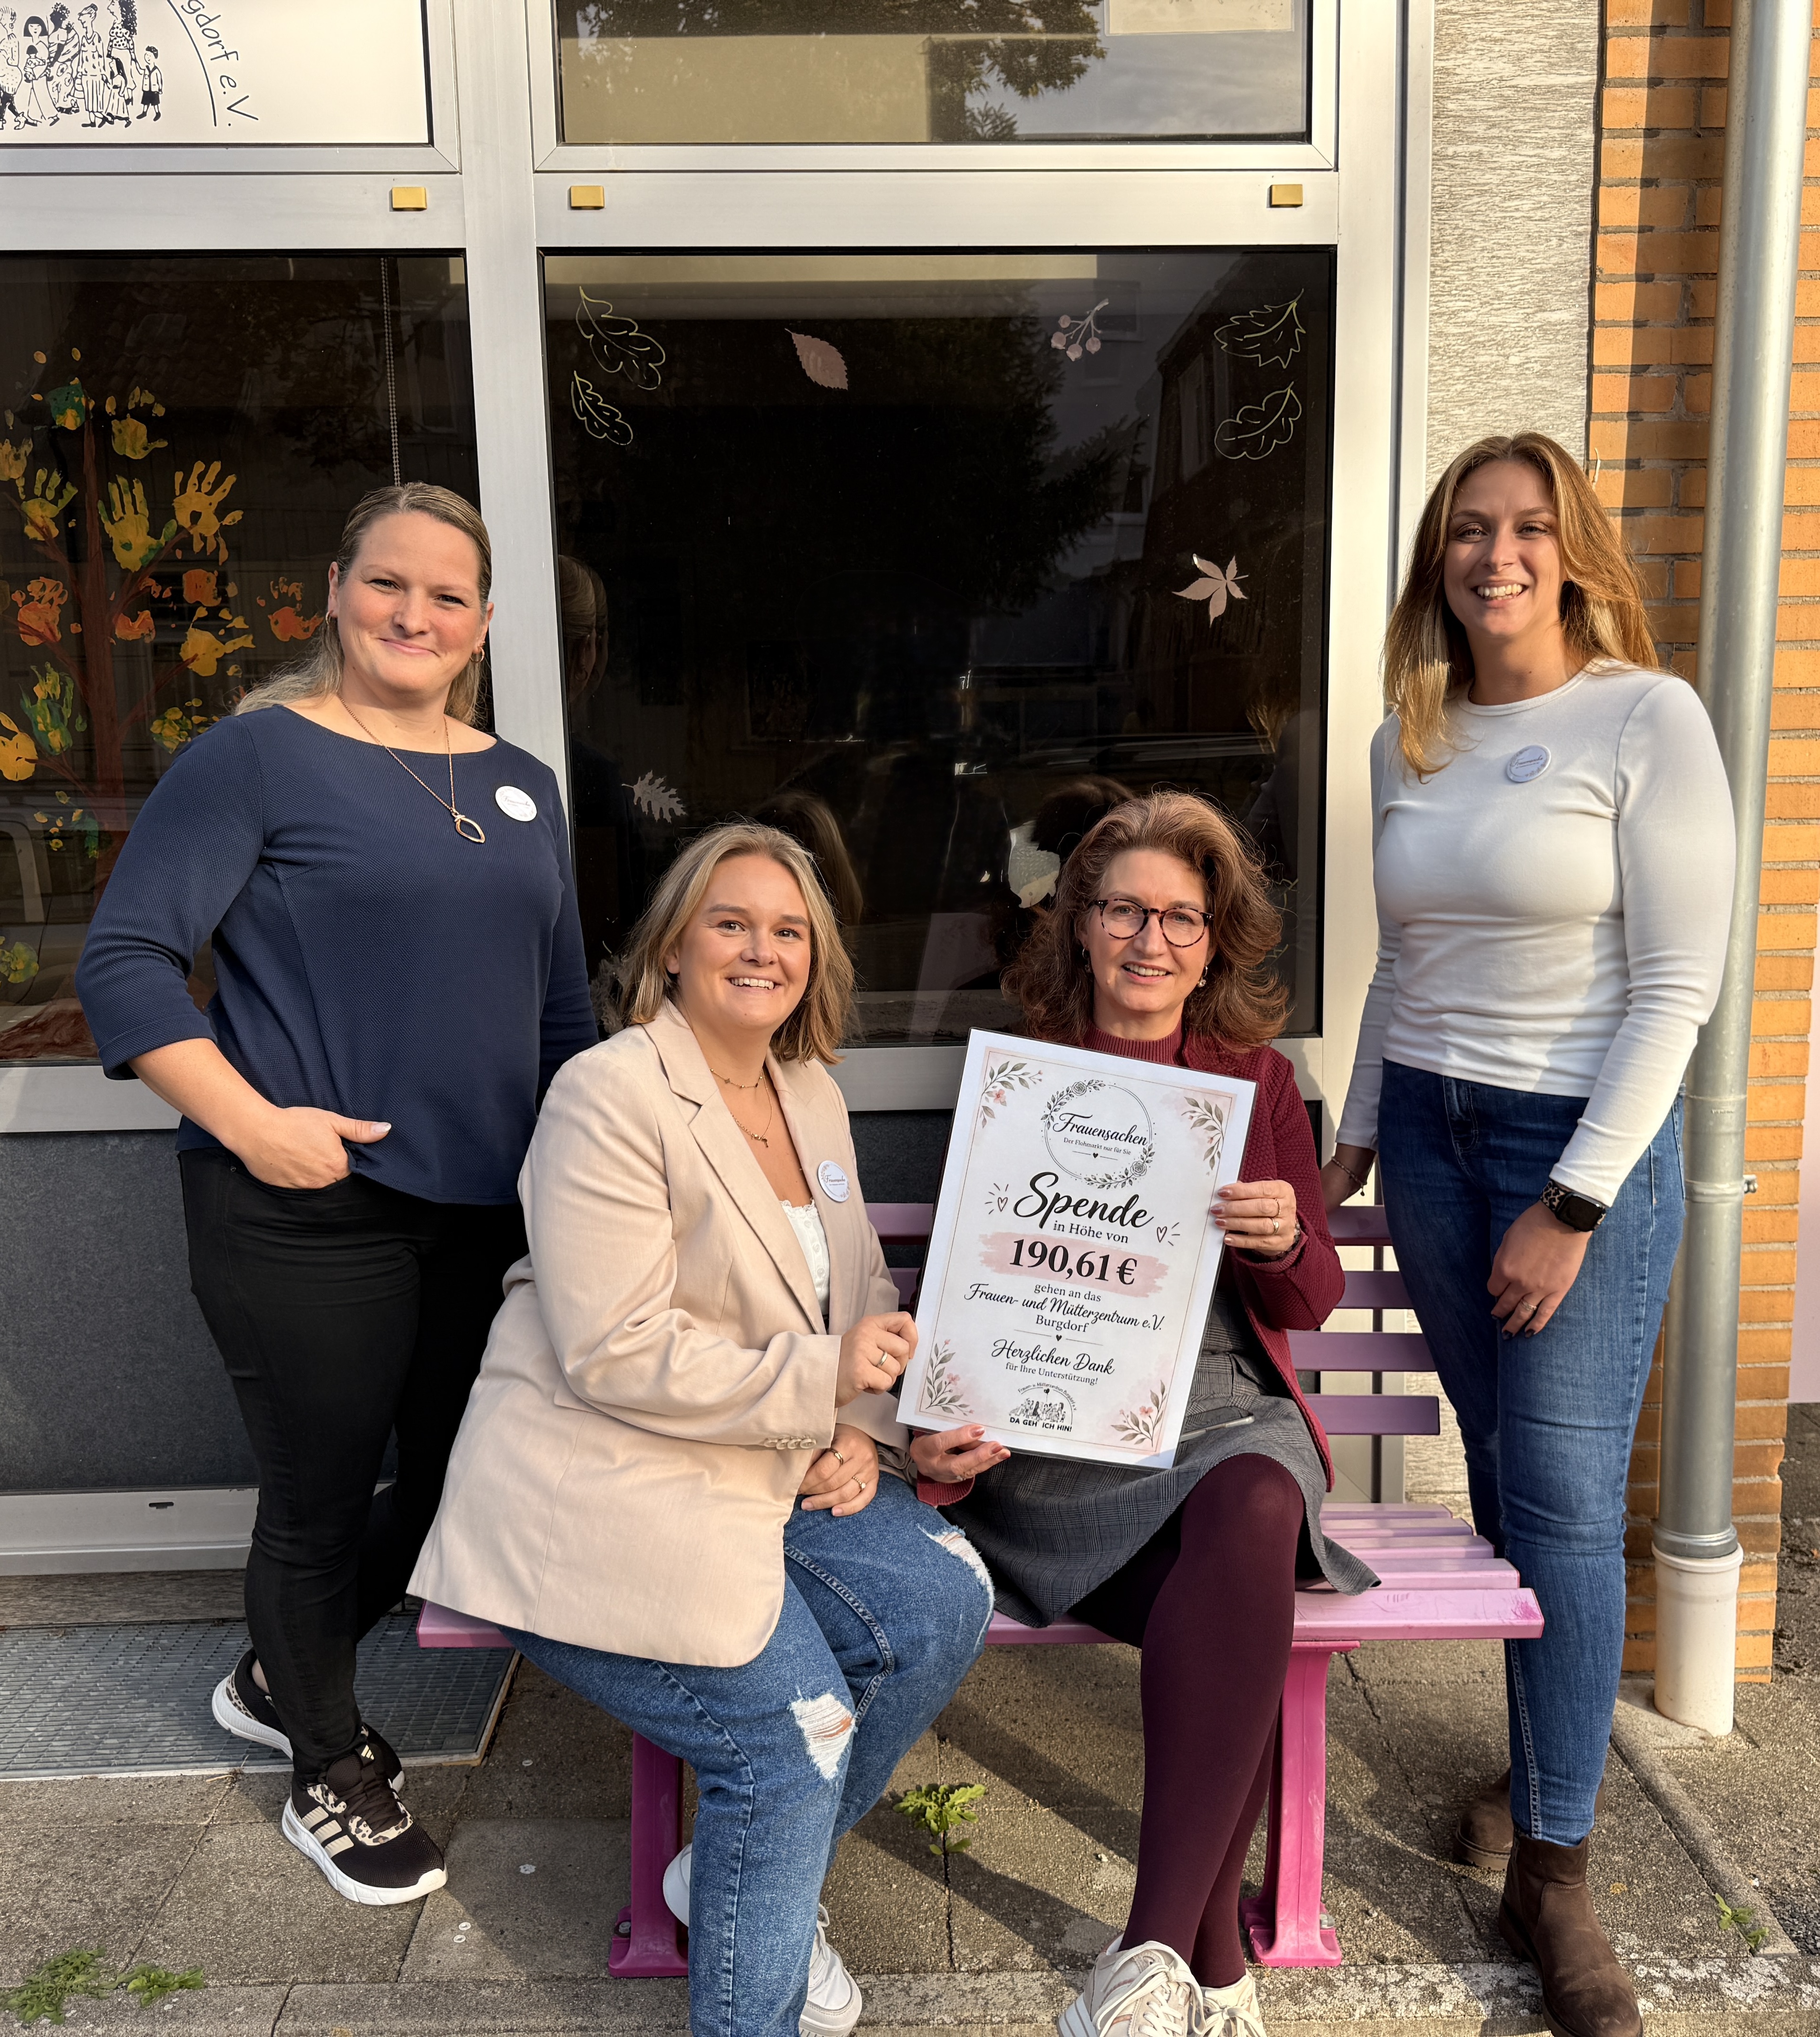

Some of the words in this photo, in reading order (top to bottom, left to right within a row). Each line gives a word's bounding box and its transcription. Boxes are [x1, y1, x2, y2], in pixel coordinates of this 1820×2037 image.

[220, 75, 259, 126] e.V.
[1052, 1113, 1148, 1146] Frauensachen
[1075, 1139, 1102, 1150] Flohmarkt
[1013, 1171, 1154, 1229] Spende
[1052, 1220, 1065, 1232] in
[1069, 1222, 1102, 1239] Höhe
[1106, 1232, 1129, 1243] von
[1009, 1239, 1110, 1281] 190,61
[1116, 1258, 1138, 1285] €
[964, 1283, 1019, 1304] Frauen-
[1022, 1297, 1049, 1310] und
[1050, 1297, 1140, 1326] Mütterzentrum
[1141, 1314, 1165, 1331] e.V.
[1034, 1284, 1065, 1296] gehen
[1069, 1290, 1081, 1299] an
[1083, 1290, 1102, 1302] das
[1035, 1314, 1089, 1332] Burgdorf
[991, 1339, 1071, 1367] Herzlichen
[1072, 1353, 1115, 1375] Dank
[1005, 1362, 1018, 1371] für
[1020, 1365, 1036, 1374] Ihre
[1038, 1368, 1098, 1386] Unterstützung!
